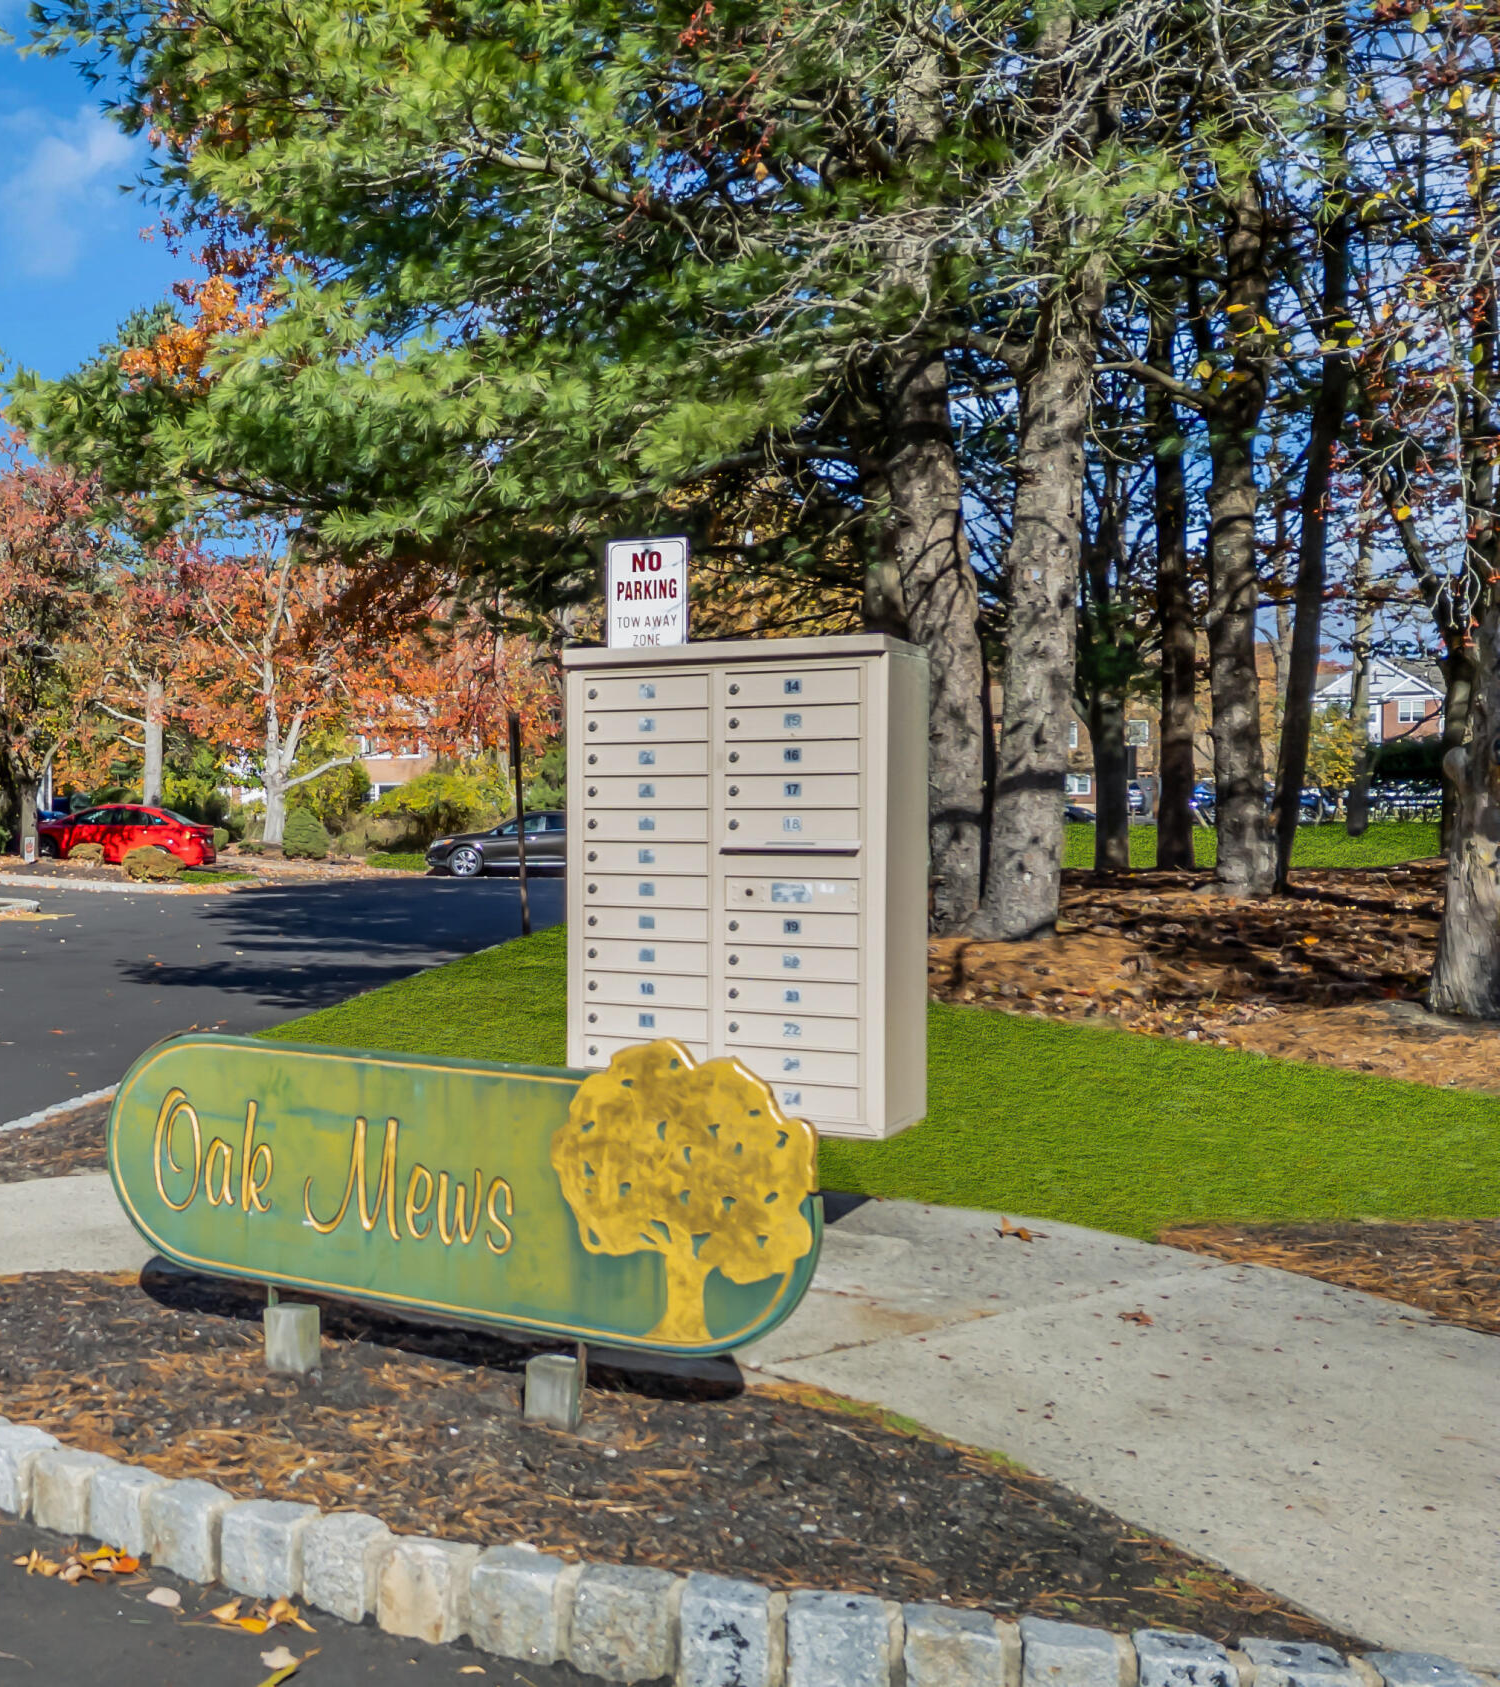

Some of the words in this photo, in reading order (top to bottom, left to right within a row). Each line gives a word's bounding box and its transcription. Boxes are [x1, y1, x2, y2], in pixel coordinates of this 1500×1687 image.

[632, 551, 662, 572] NO
[617, 578, 677, 601] PARKING
[617, 616, 640, 628] TOW
[644, 614, 677, 627] AWAY
[632, 634, 661, 647] ZONE
[786, 680, 800, 692] 14
[786, 749, 800, 761] 16
[786, 783, 800, 795] 17
[786, 818, 801, 830] 18
[786, 921, 800, 932] 19
[153, 1086, 274, 1213] Oak
[303, 1116, 515, 1256] Mews
